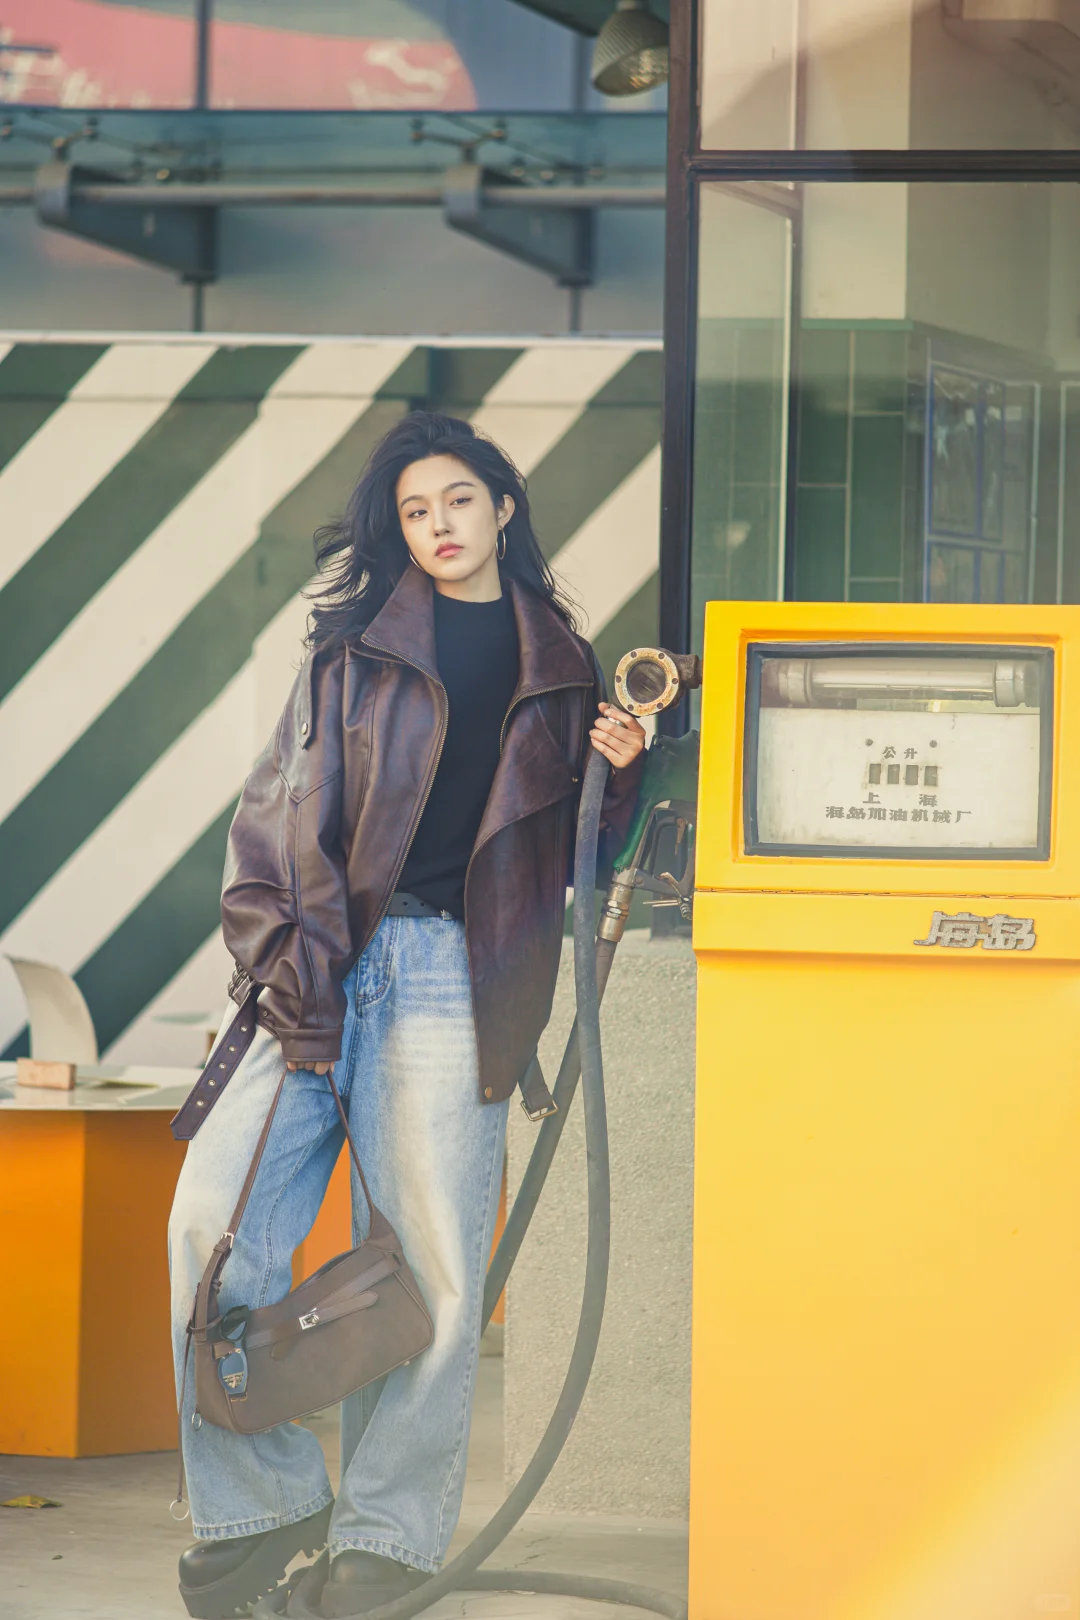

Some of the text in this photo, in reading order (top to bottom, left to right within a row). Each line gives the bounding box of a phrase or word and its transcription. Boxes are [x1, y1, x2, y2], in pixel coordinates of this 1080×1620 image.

[882, 746, 918, 760] 公升
[862, 792, 938, 807] 上海
[825, 806, 972, 824] 海岛加油机械厂
